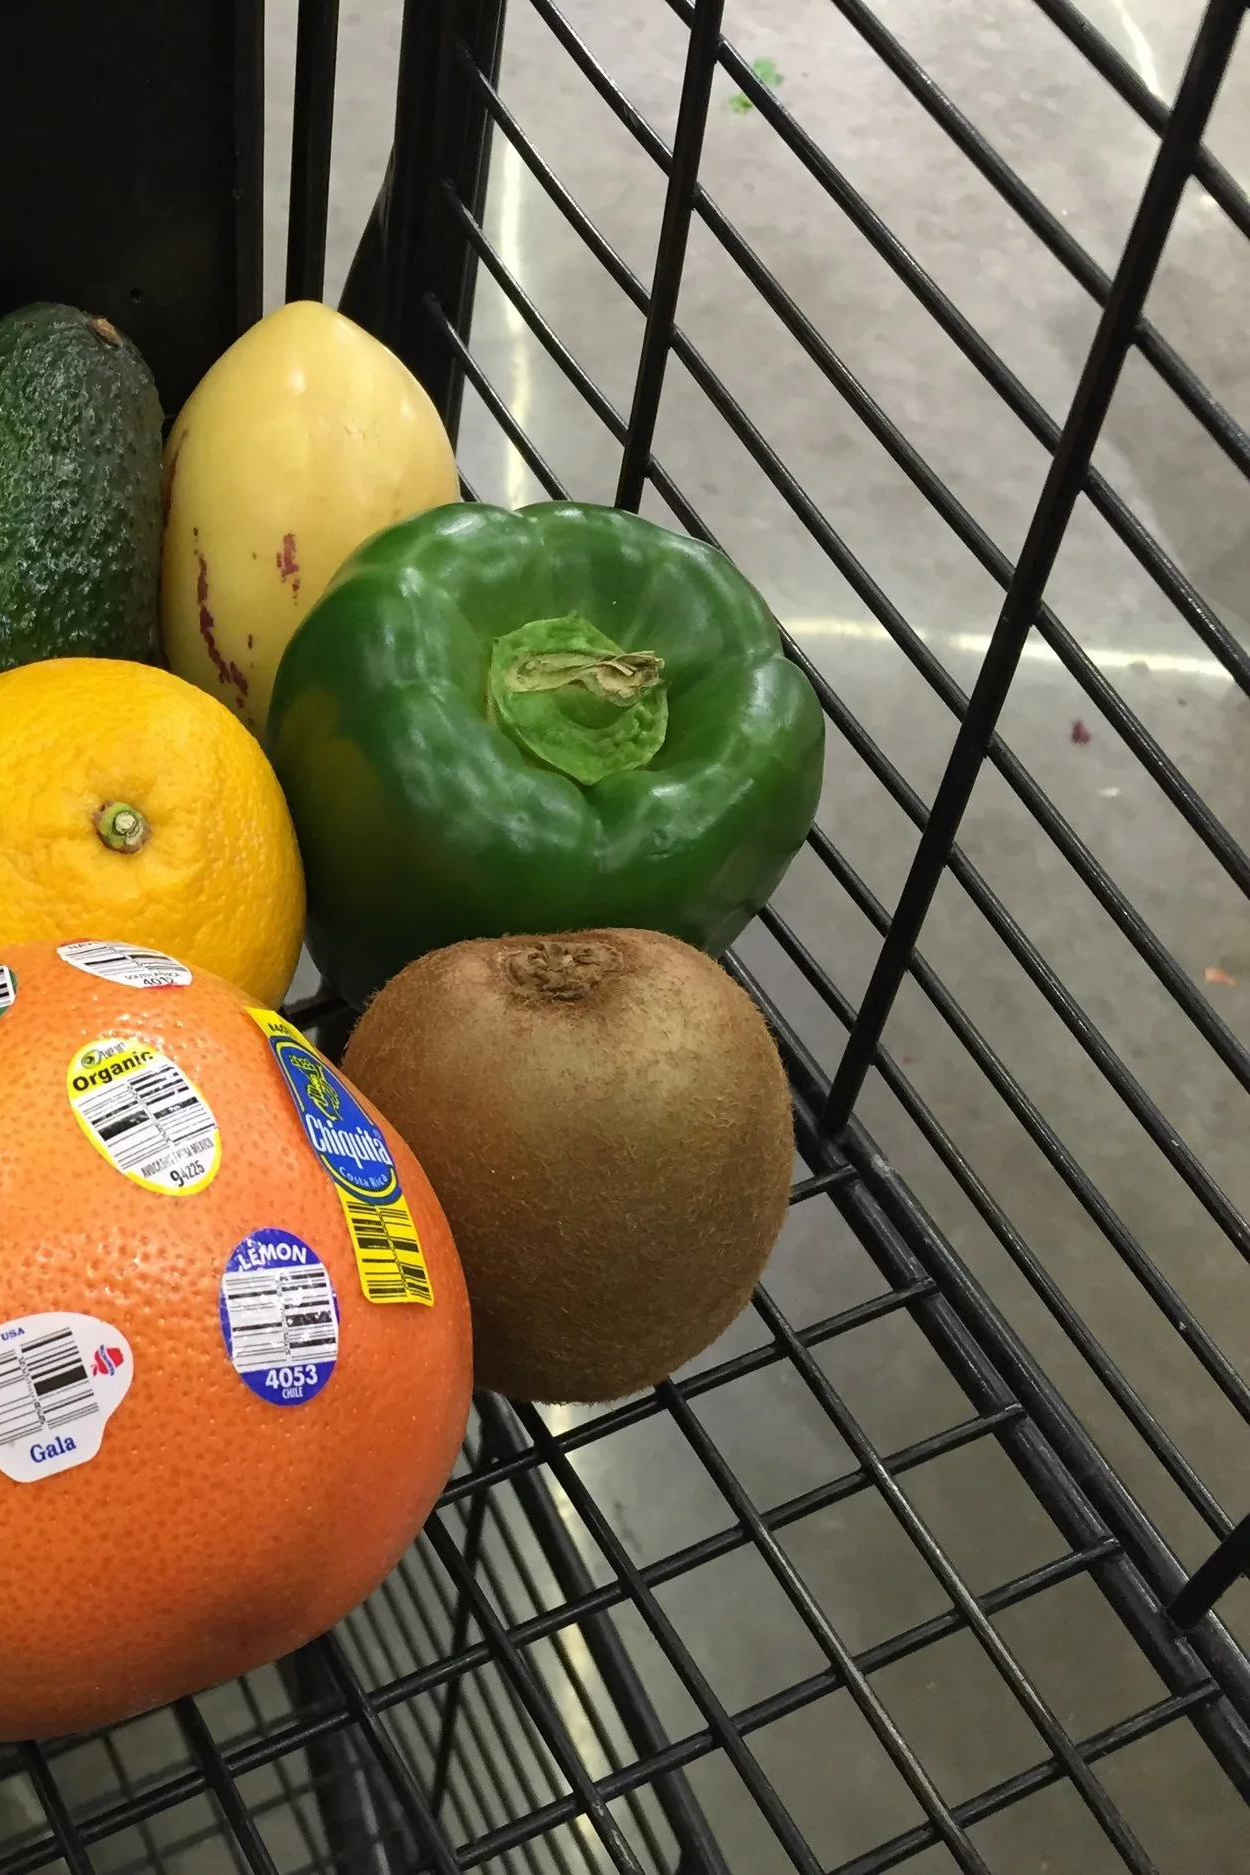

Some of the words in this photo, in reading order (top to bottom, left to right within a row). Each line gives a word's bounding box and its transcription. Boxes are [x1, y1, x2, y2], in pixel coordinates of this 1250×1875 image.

[72, 1051, 153, 1091] Organic
[305, 1113, 393, 1170] Chiquita
[170, 1160, 205, 1187] 94225
[339, 1166, 369, 1187] Costa
[369, 1173, 389, 1188] Rica
[237, 1243, 307, 1270] LEMON
[0, 1327, 25, 1341] USA
[265, 1364, 318, 1389] 4053
[281, 1386, 303, 1399] CHILE
[30, 1436, 77, 1463] Gala
